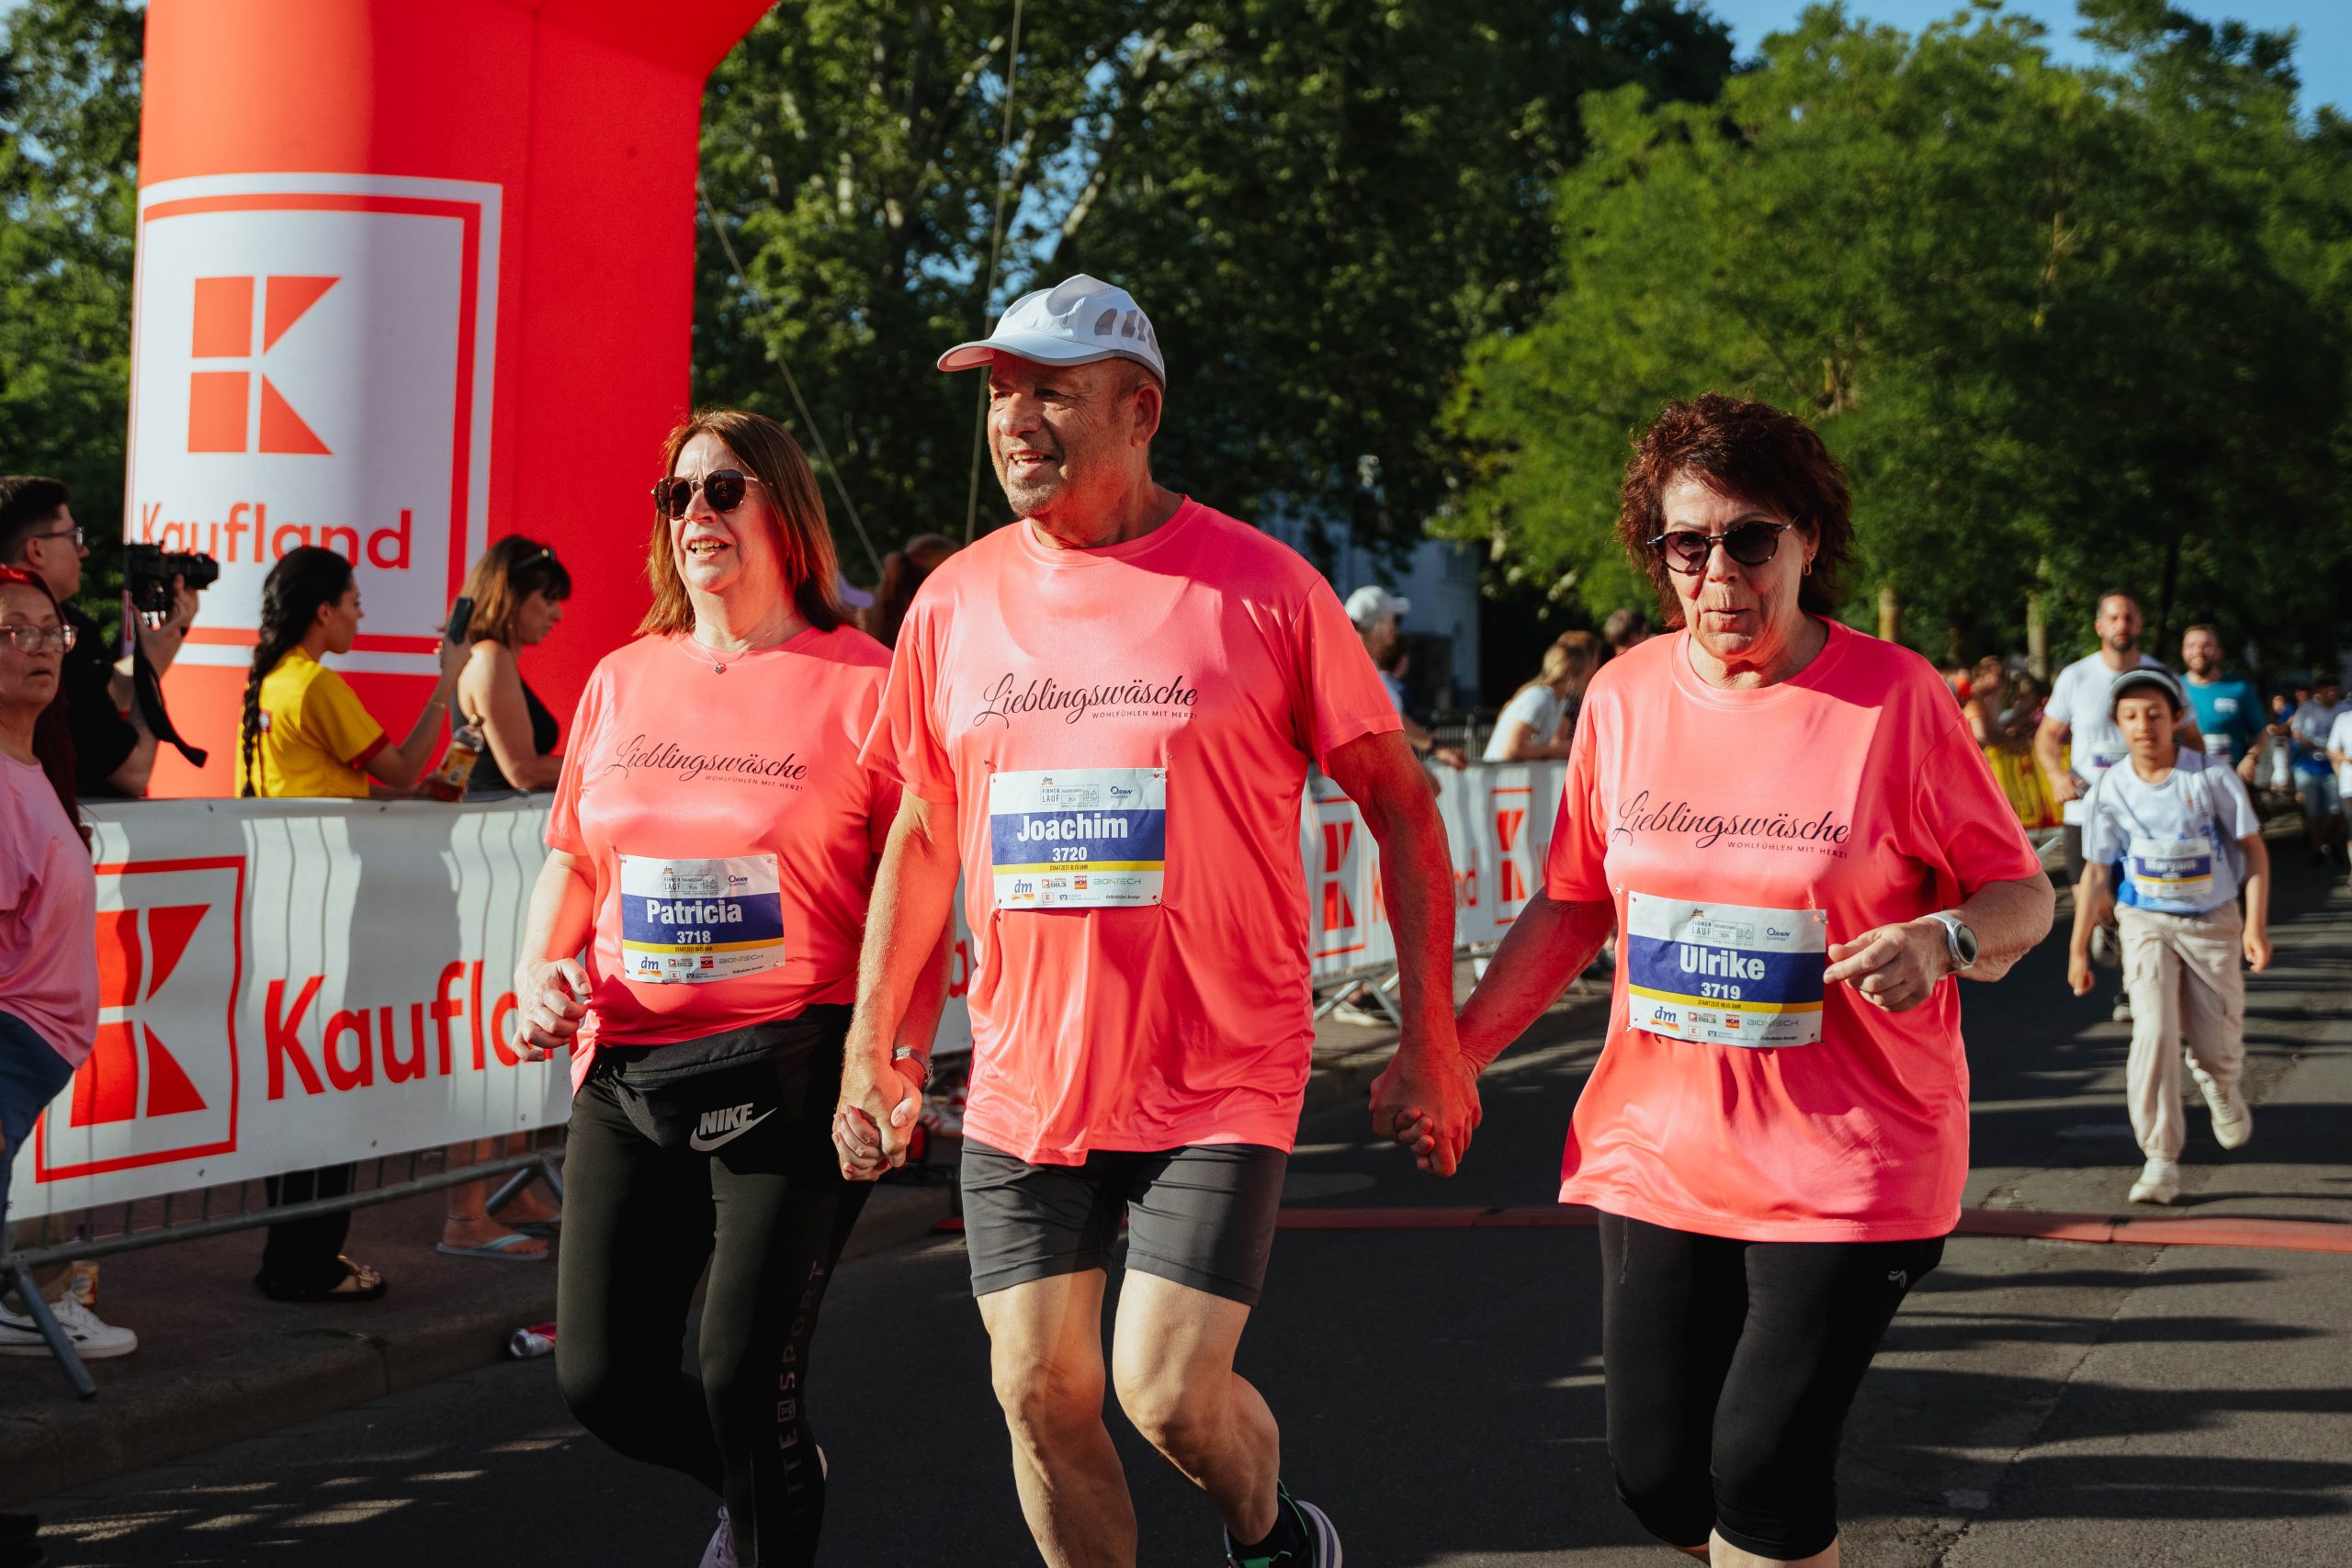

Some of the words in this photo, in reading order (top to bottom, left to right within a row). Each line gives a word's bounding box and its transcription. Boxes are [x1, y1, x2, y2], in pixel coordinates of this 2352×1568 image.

[142, 502, 412, 570] Kaufland
[973, 672, 1198, 729] Lieblingswäsche
[1091, 710, 1148, 719] WOHLFÜHLEN
[603, 734, 807, 782] Lieblingswäsche
[705, 774, 758, 784] WOHLFÜHLEN
[779, 783, 803, 792] HERZ!
[1042, 795, 1060, 803] LAUF
[1016, 813, 1128, 841] Joachim
[1611, 790, 1849, 849] Lieblingswäsche
[1052, 847, 1088, 861] 3720
[1727, 841, 1792, 852] WOHLFÜHLEN
[1819, 848, 1848, 859] HERZ!
[664, 882, 681, 890] LAUF
[1014, 879, 1033, 893] dm
[646, 899, 743, 925] Patricia
[676, 931, 711, 943] 3718
[1691, 927, 1712, 935] LAUF
[640, 956, 659, 970] dm
[1679, 944, 1766, 980] Ulrike
[1701, 982, 1741, 999] 3719
[1654, 1006, 1677, 1023] dm
[1747, 1019, 1798, 1027] BIONTECH
[265, 960, 579, 1100] Kaufla
[699, 1102, 753, 1135] NIKE
[779, 1260, 824, 1389] SPORT
